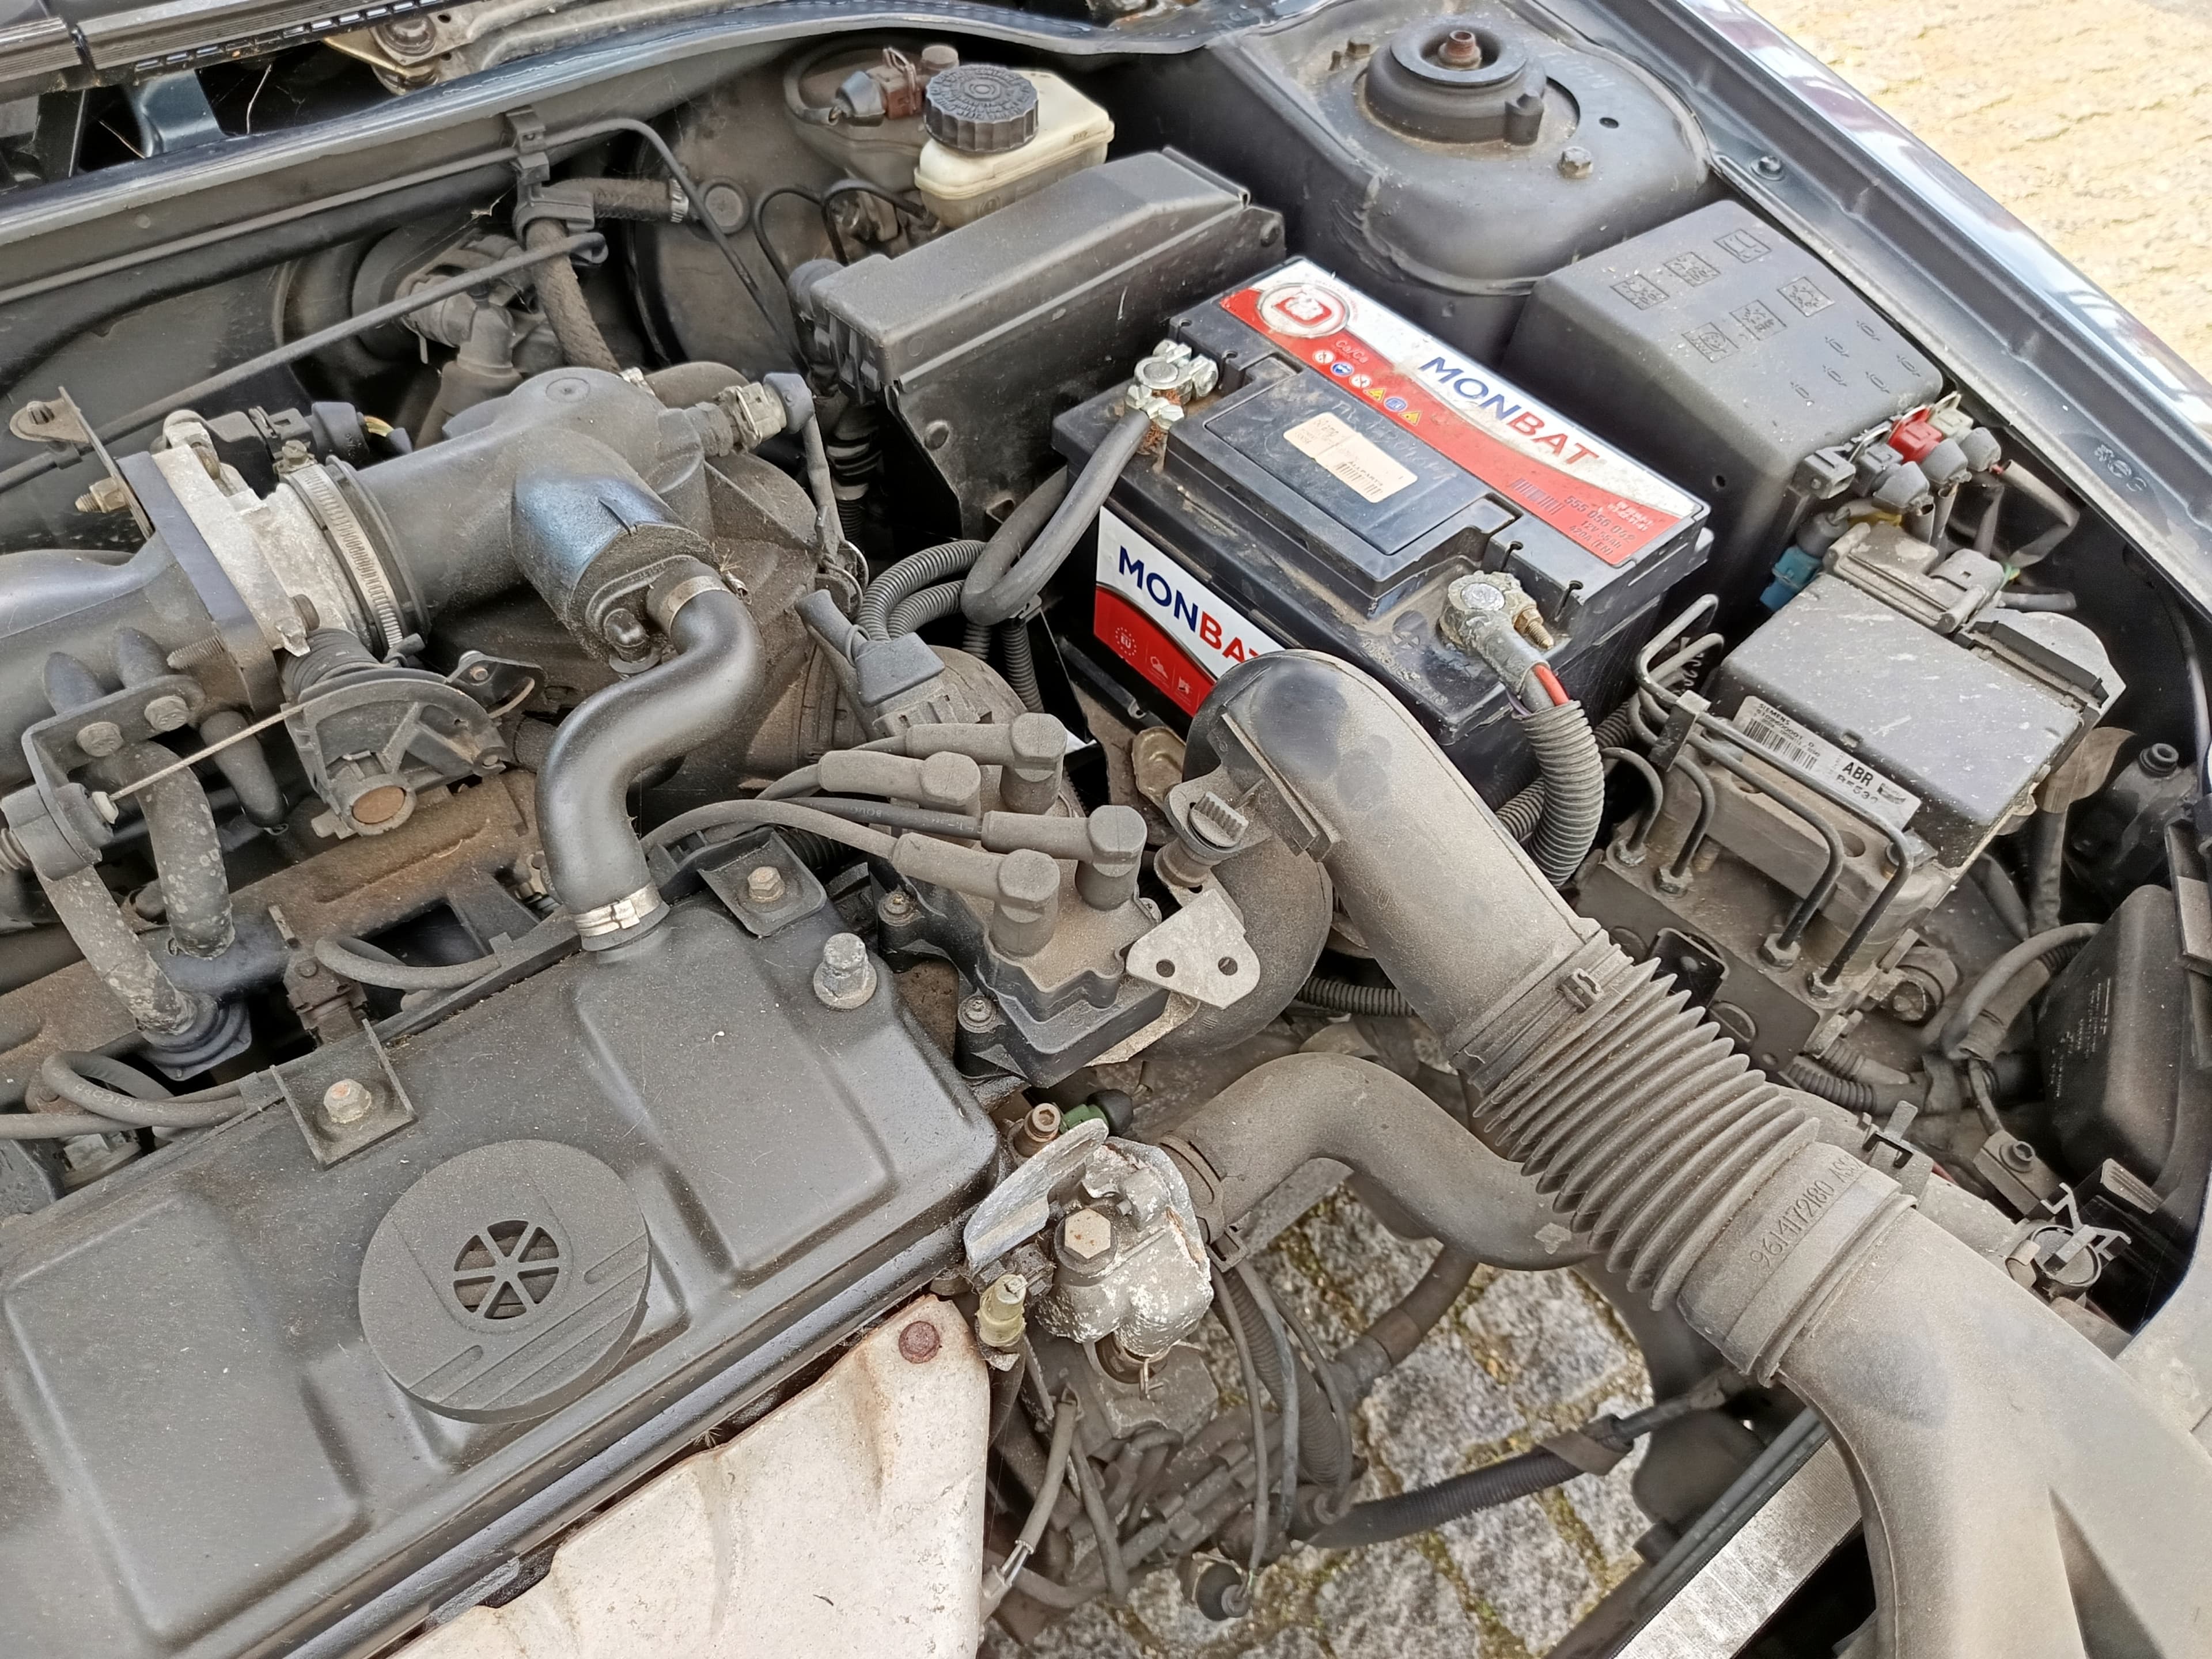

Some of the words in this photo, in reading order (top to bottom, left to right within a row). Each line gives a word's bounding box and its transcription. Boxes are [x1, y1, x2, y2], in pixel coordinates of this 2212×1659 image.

[1418, 355, 1600, 465] MONBAT
[1563, 495, 1589, 513] 555
[1588, 509, 1612, 527] 056
[1120, 635, 1132, 649] EU
[1758, 703, 1790, 725] SIEMENS
[1842, 761, 1874, 786] ABR
[1749, 1180, 1835, 1268] 9614172180
